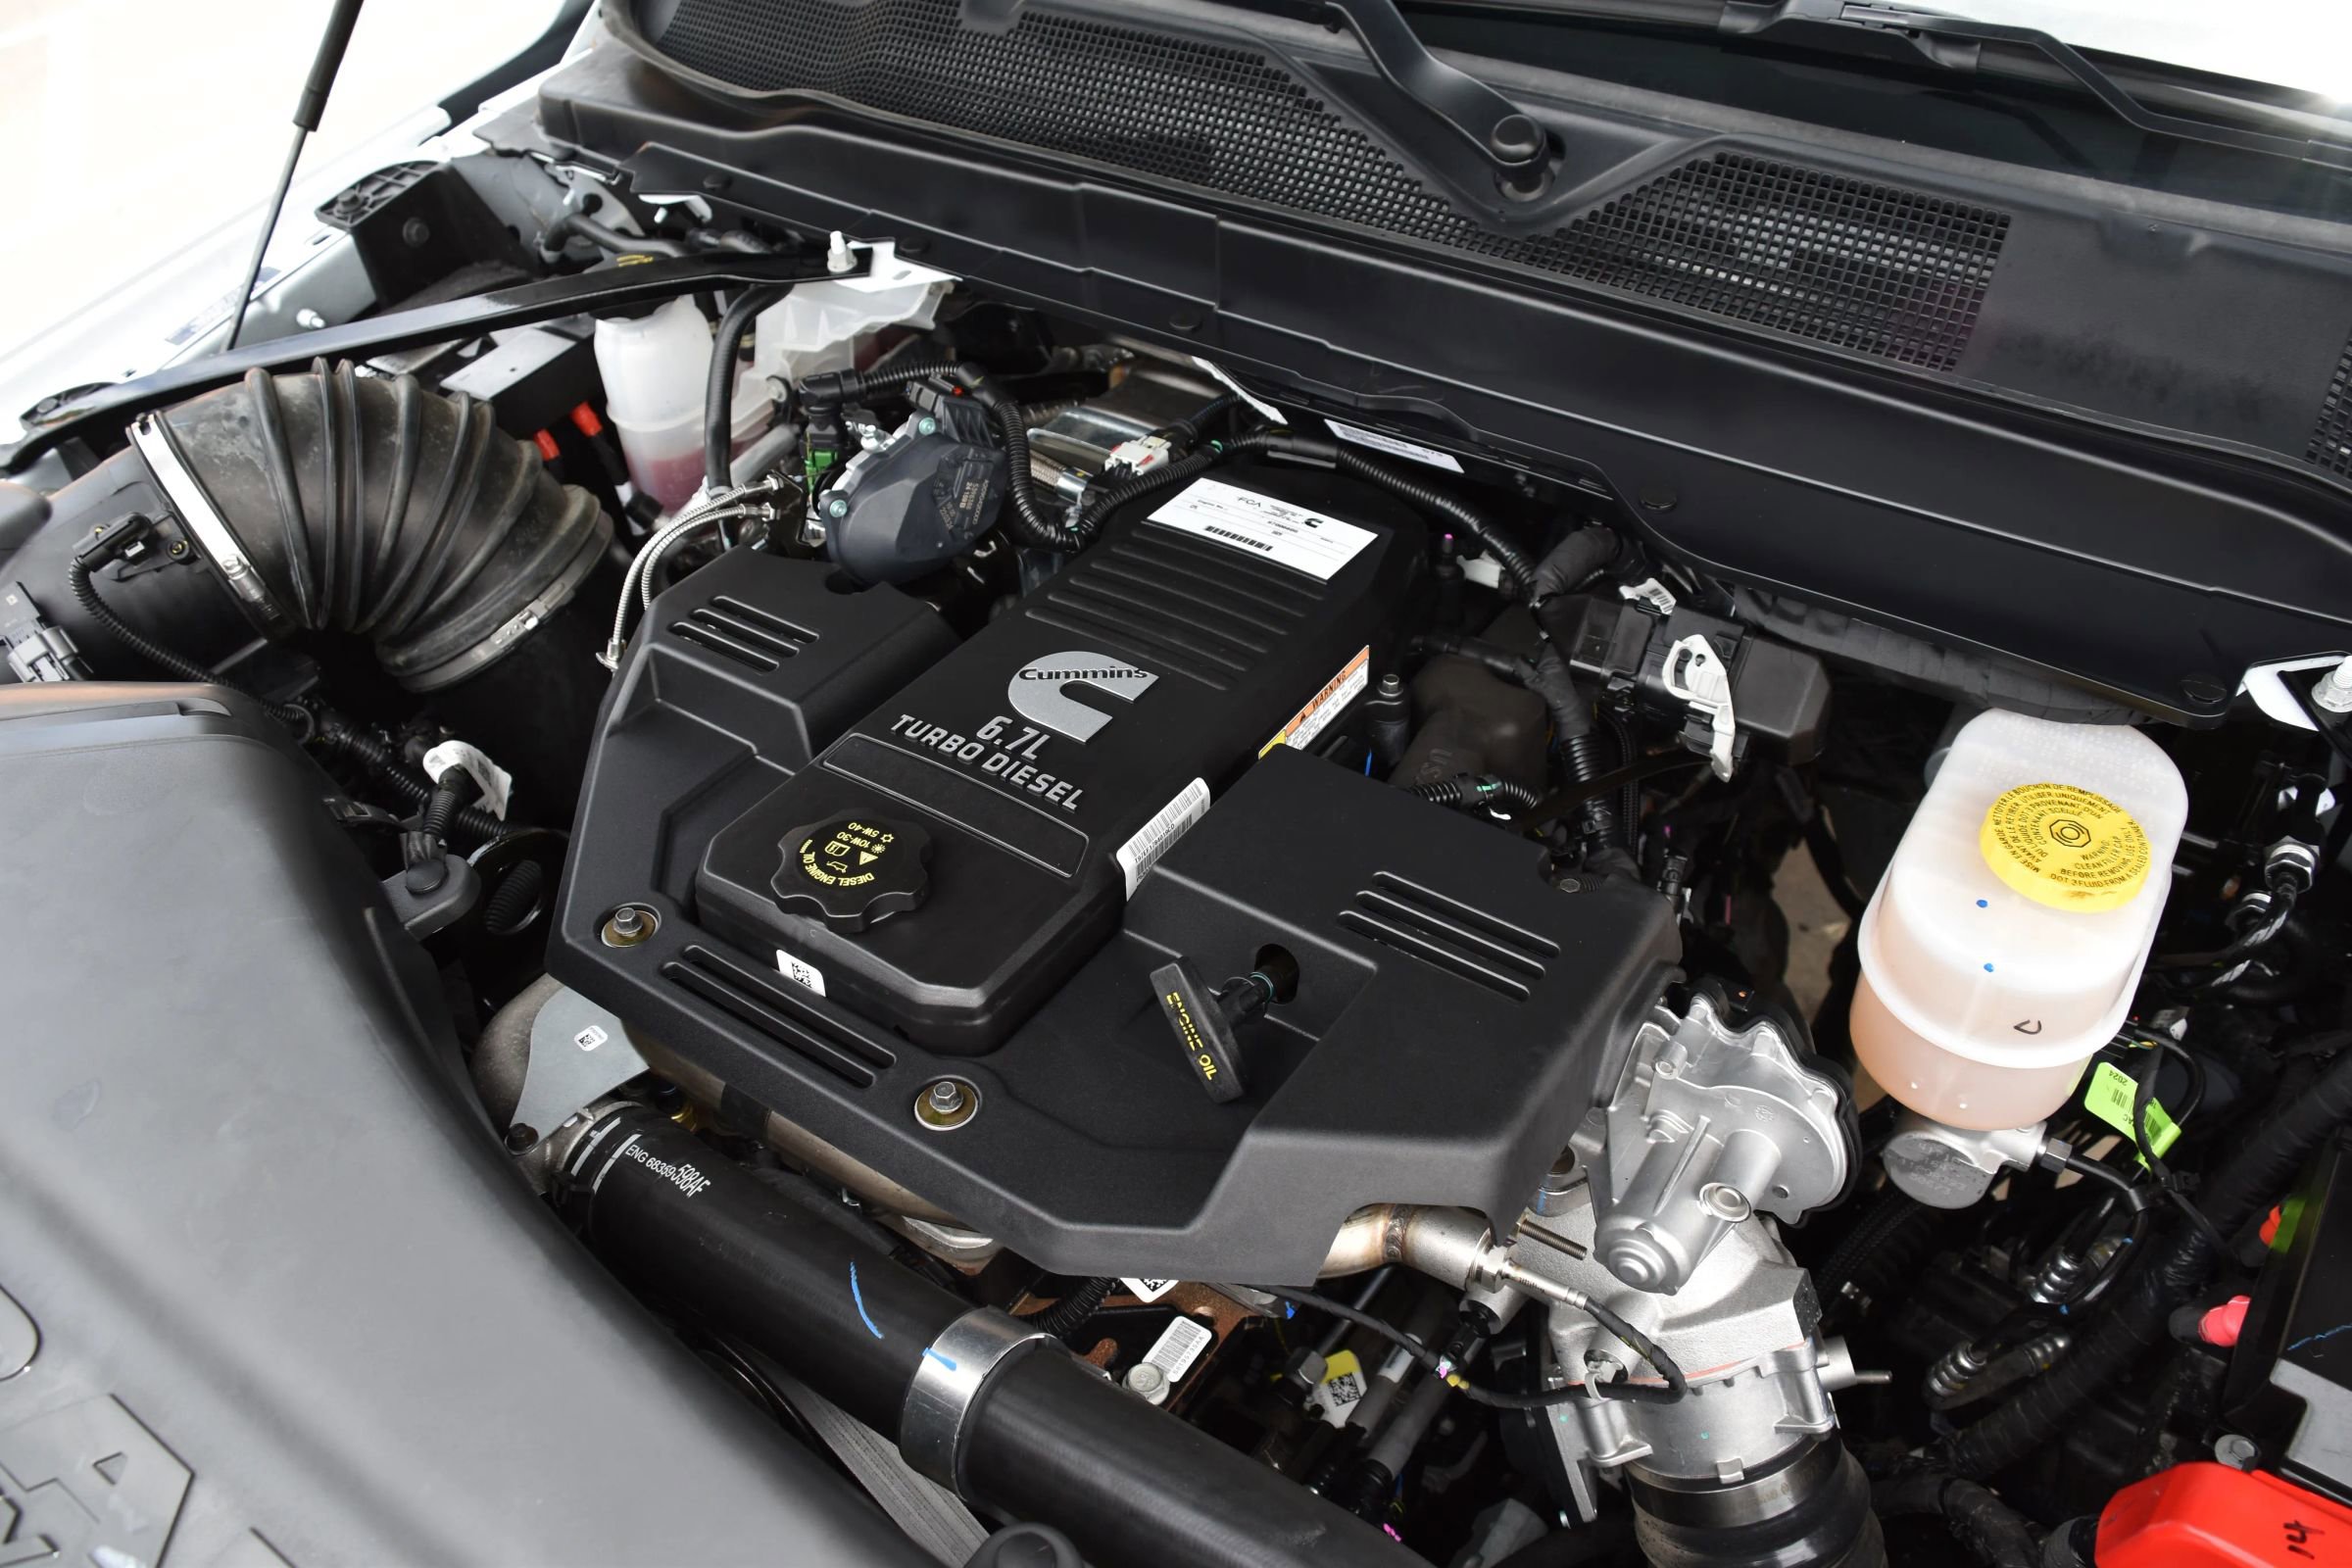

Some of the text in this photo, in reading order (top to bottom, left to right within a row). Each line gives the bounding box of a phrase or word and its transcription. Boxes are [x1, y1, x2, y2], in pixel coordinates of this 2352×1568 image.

[1018, 665, 1149, 681] Cummins
[1311, 669, 1348, 710] WARNING
[976, 715, 1051, 760] 6.7L
[890, 713, 1084, 811] TURBO DIESEL
[2012, 783, 2051, 796] BOUCHON
[2030, 800, 2080, 808] PROVENANT
[848, 821, 880, 838] 5W-40
[837, 831, 870, 849] 10W-30
[803, 851, 875, 887] DIESEL ENGINE OIL
[2060, 868, 2097, 879] BEFORE
[2050, 873, 2069, 883] DOT
[1166, 992, 1217, 1081] ENGINE OIL
[2109, 1070, 2129, 1087] 2024
[625, 1144, 649, 1163] ENG
